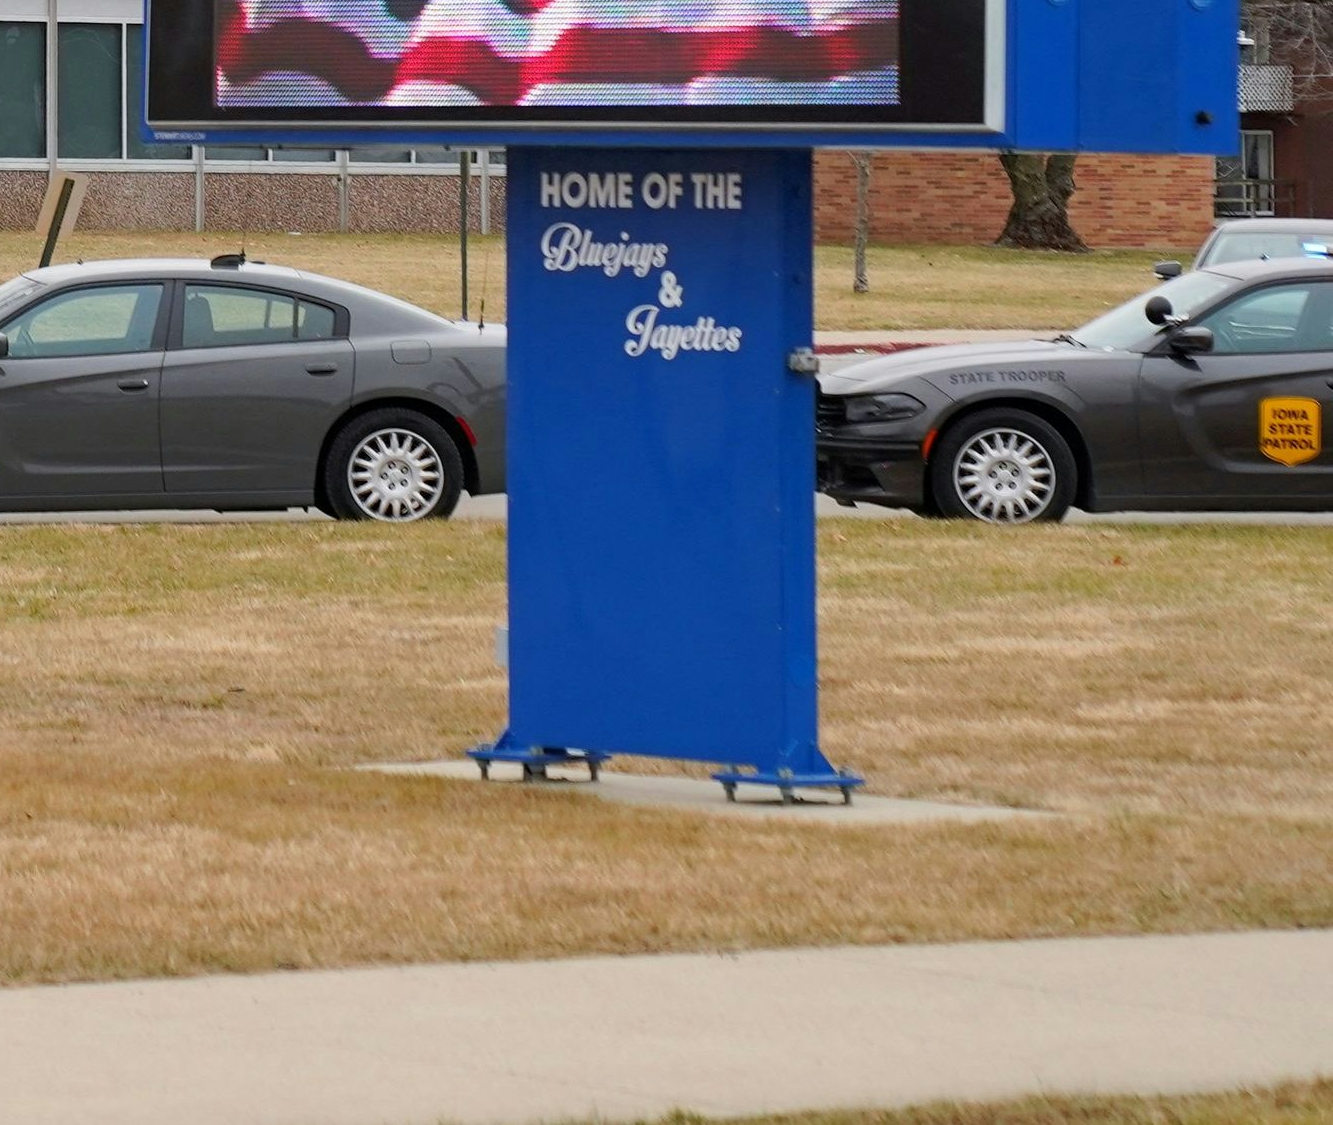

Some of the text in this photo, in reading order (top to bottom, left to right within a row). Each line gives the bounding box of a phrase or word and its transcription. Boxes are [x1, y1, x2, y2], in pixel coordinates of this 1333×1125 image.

[540, 172, 742, 210] HOME OF THE
[541, 222, 668, 277] Bluejays
[658, 270, 683, 308] &
[624, 304, 742, 360] Jayettes
[949, 370, 1067, 386] STATE TROOPER
[1272, 409, 1309, 421] IOWA
[1268, 423, 1313, 436] STATE
[1263, 437, 1317, 450] PATROL
